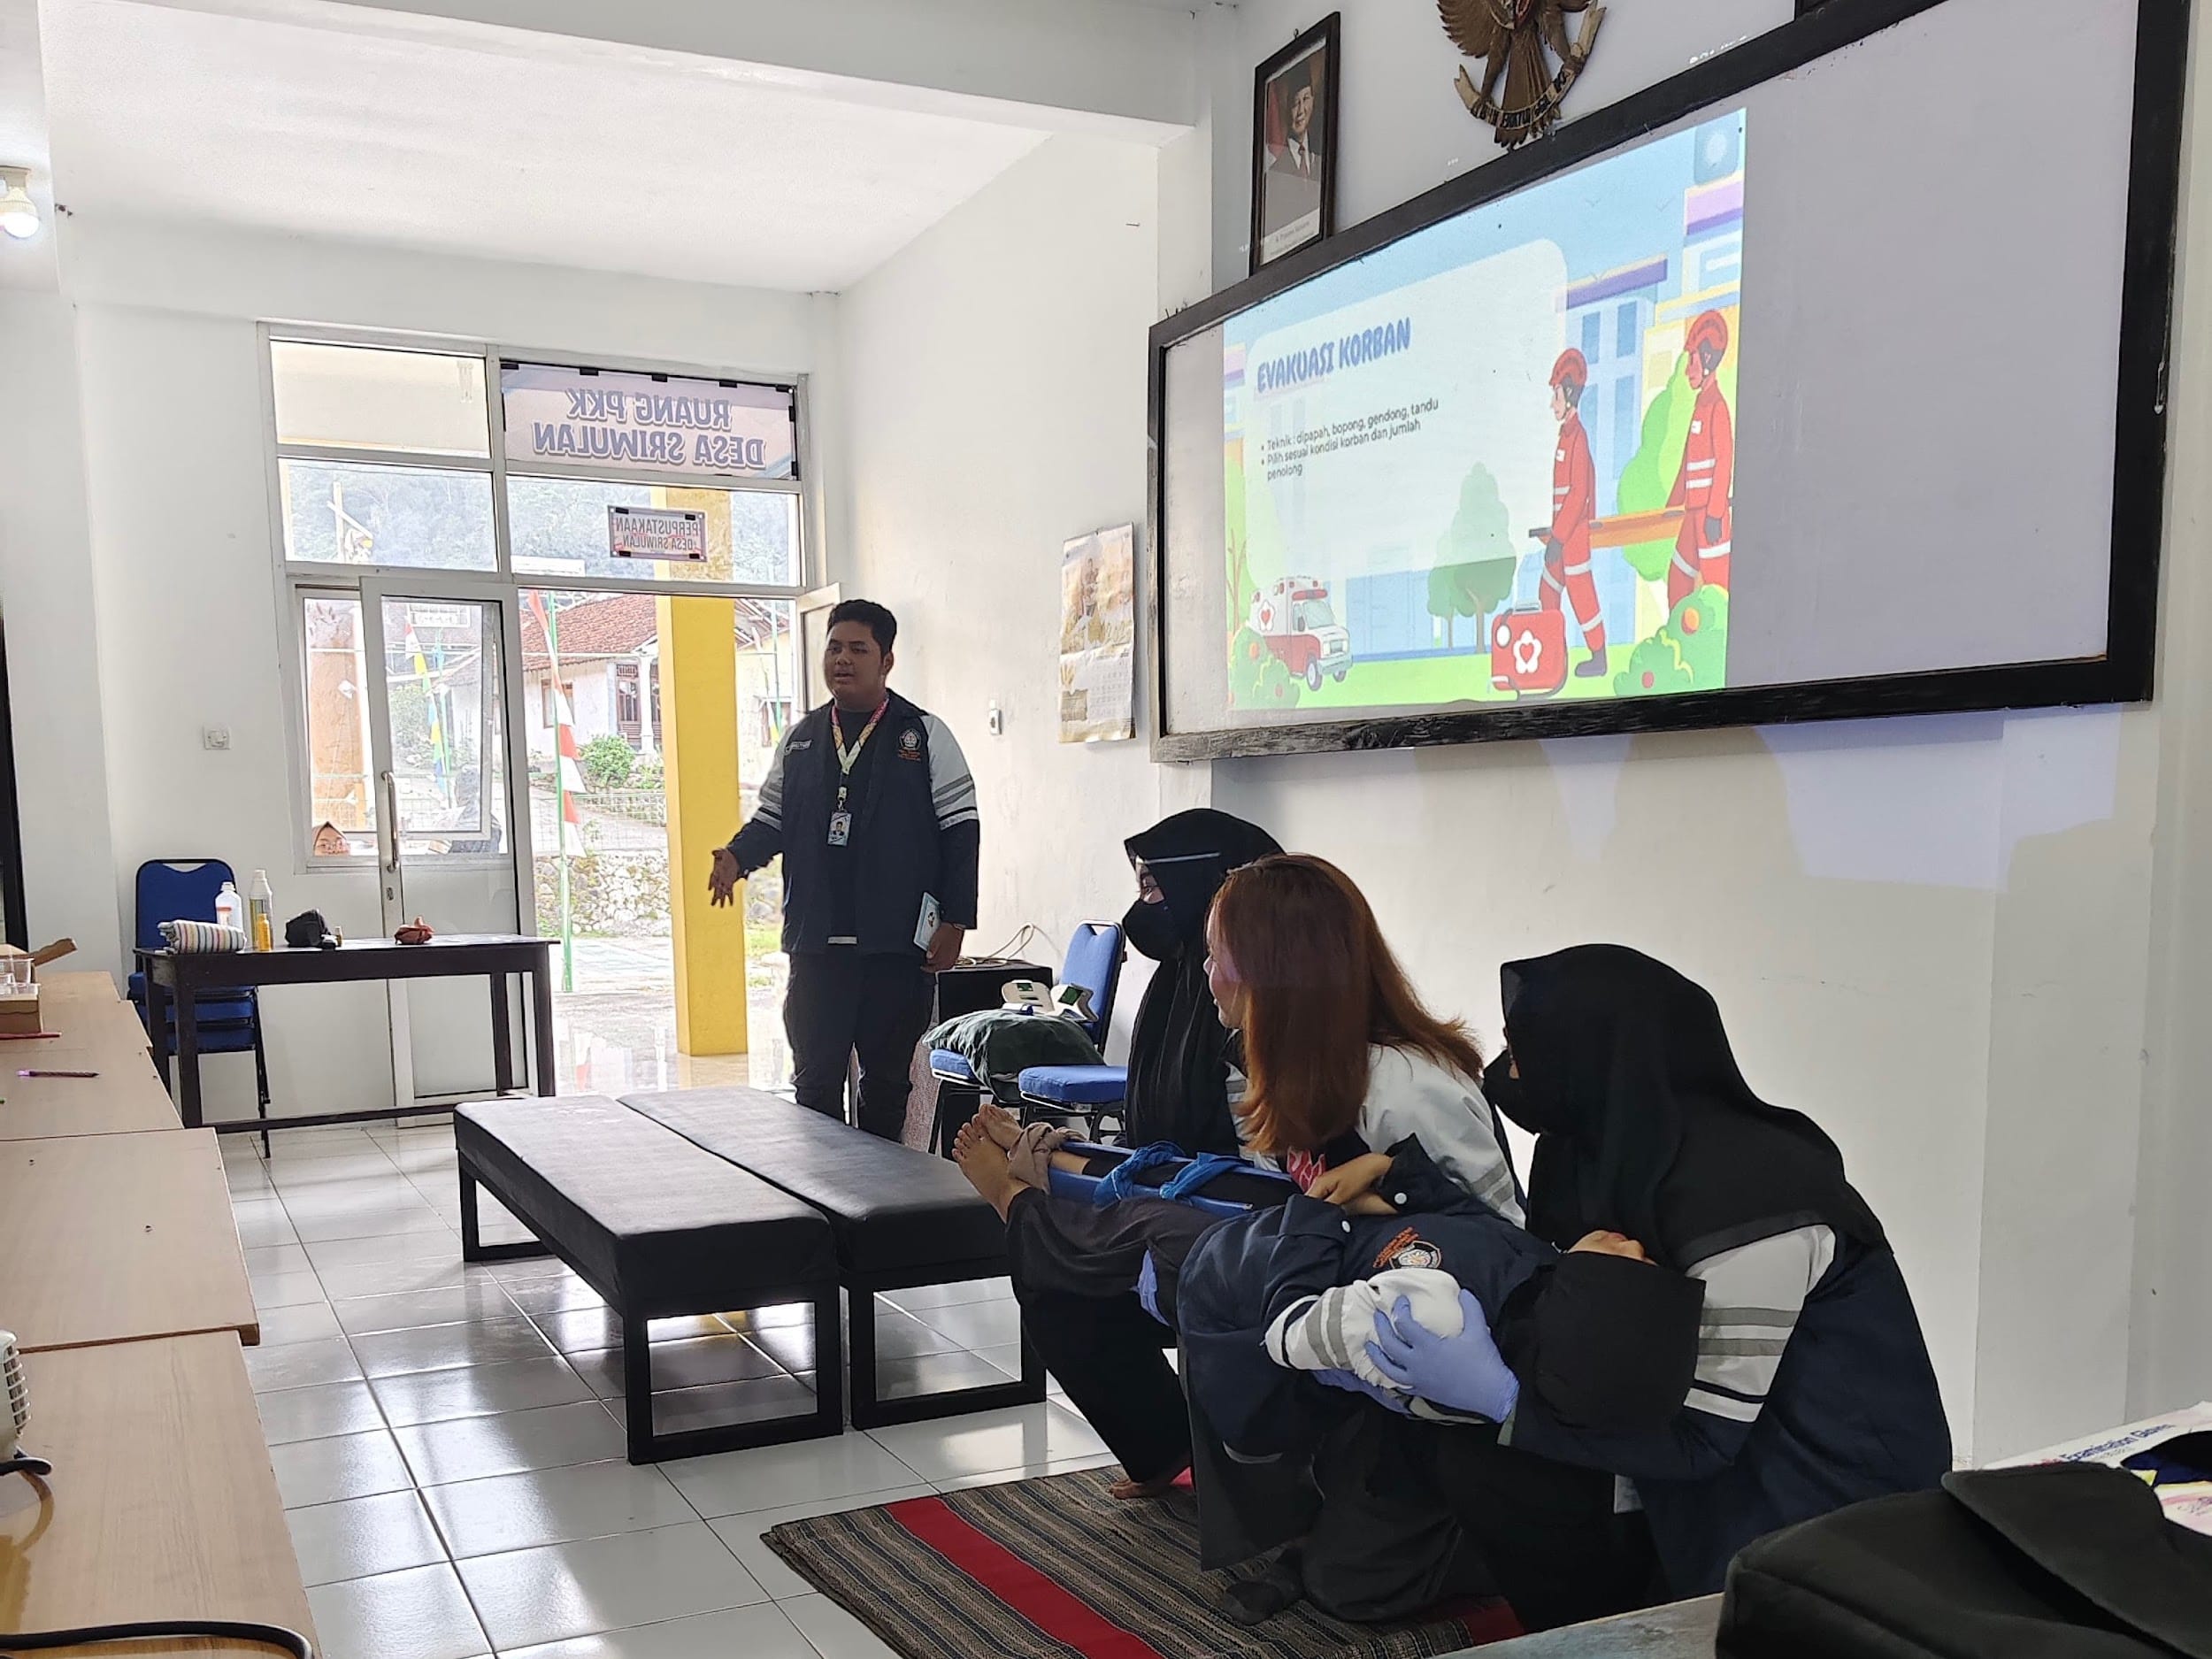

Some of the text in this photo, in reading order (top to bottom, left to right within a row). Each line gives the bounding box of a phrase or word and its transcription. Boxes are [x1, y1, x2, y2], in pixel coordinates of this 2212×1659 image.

[1257, 317, 1410, 393] EVAKUASI KORBAN
[1333, 419, 1366, 437] bopong,
[1368, 408, 1409, 428] gendong,
[1411, 397, 1439, 415] tandu
[1285, 445, 1309, 462] sesuai
[1310, 439, 1339, 456] kondisi
[1340, 432, 1369, 449] korban
[1371, 427, 1388, 442] dan
[1388, 419, 1421, 441] jumlah
[1268, 463, 1303, 481] penolong
